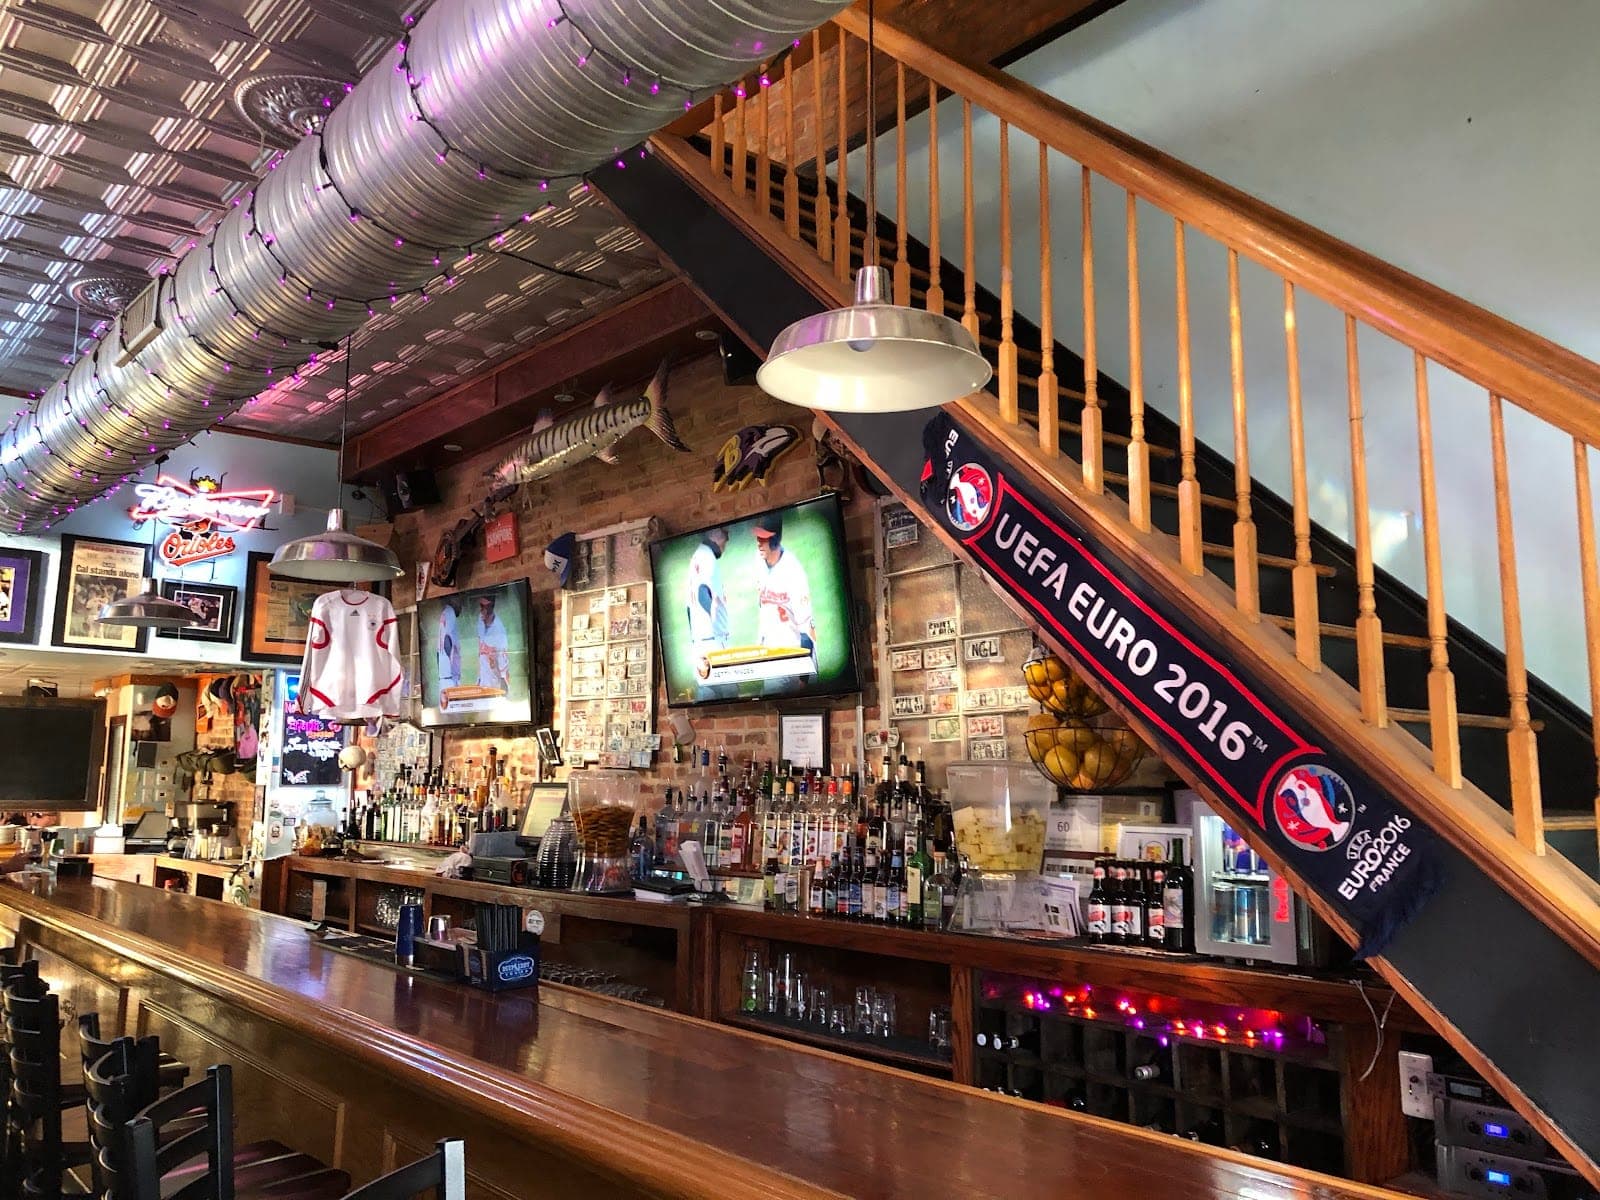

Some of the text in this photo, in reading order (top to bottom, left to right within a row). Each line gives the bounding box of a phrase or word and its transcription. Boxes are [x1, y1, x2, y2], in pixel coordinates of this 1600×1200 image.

[162, 530, 236, 562] Orioles
[993, 511, 1069, 601] UEFA
[1067, 581, 1158, 678] EURO
[1153, 661, 1252, 762] 2016
[1057, 821, 1070, 832] 60
[1368, 843, 1412, 893] FRANCE
